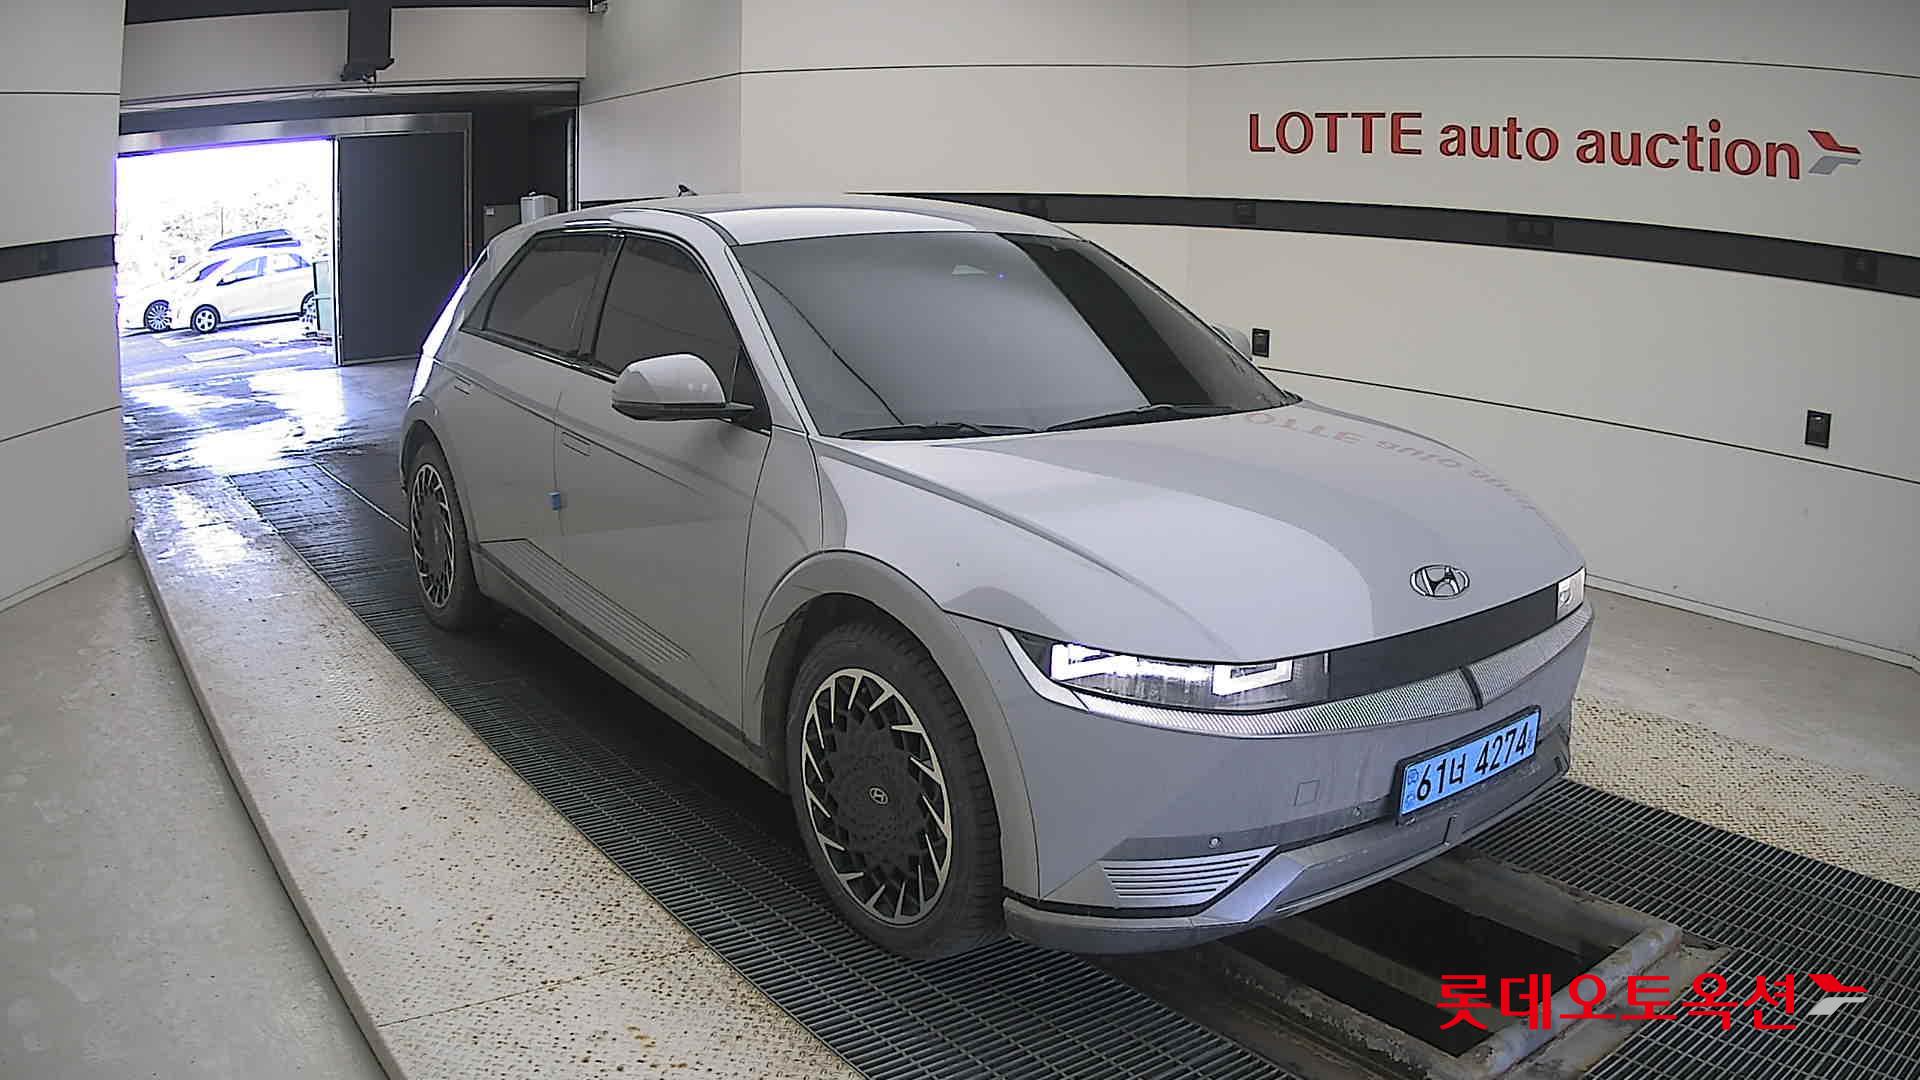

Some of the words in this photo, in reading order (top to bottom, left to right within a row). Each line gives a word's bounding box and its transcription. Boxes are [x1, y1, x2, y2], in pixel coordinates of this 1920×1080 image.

[1249, 111, 1424, 155] LOTTE
[1438, 117, 1561, 162] auto
[1575, 119, 1803, 181] auction
[1416, 753, 1467, 801] 61너
[1474, 721, 1529, 776] 4274
